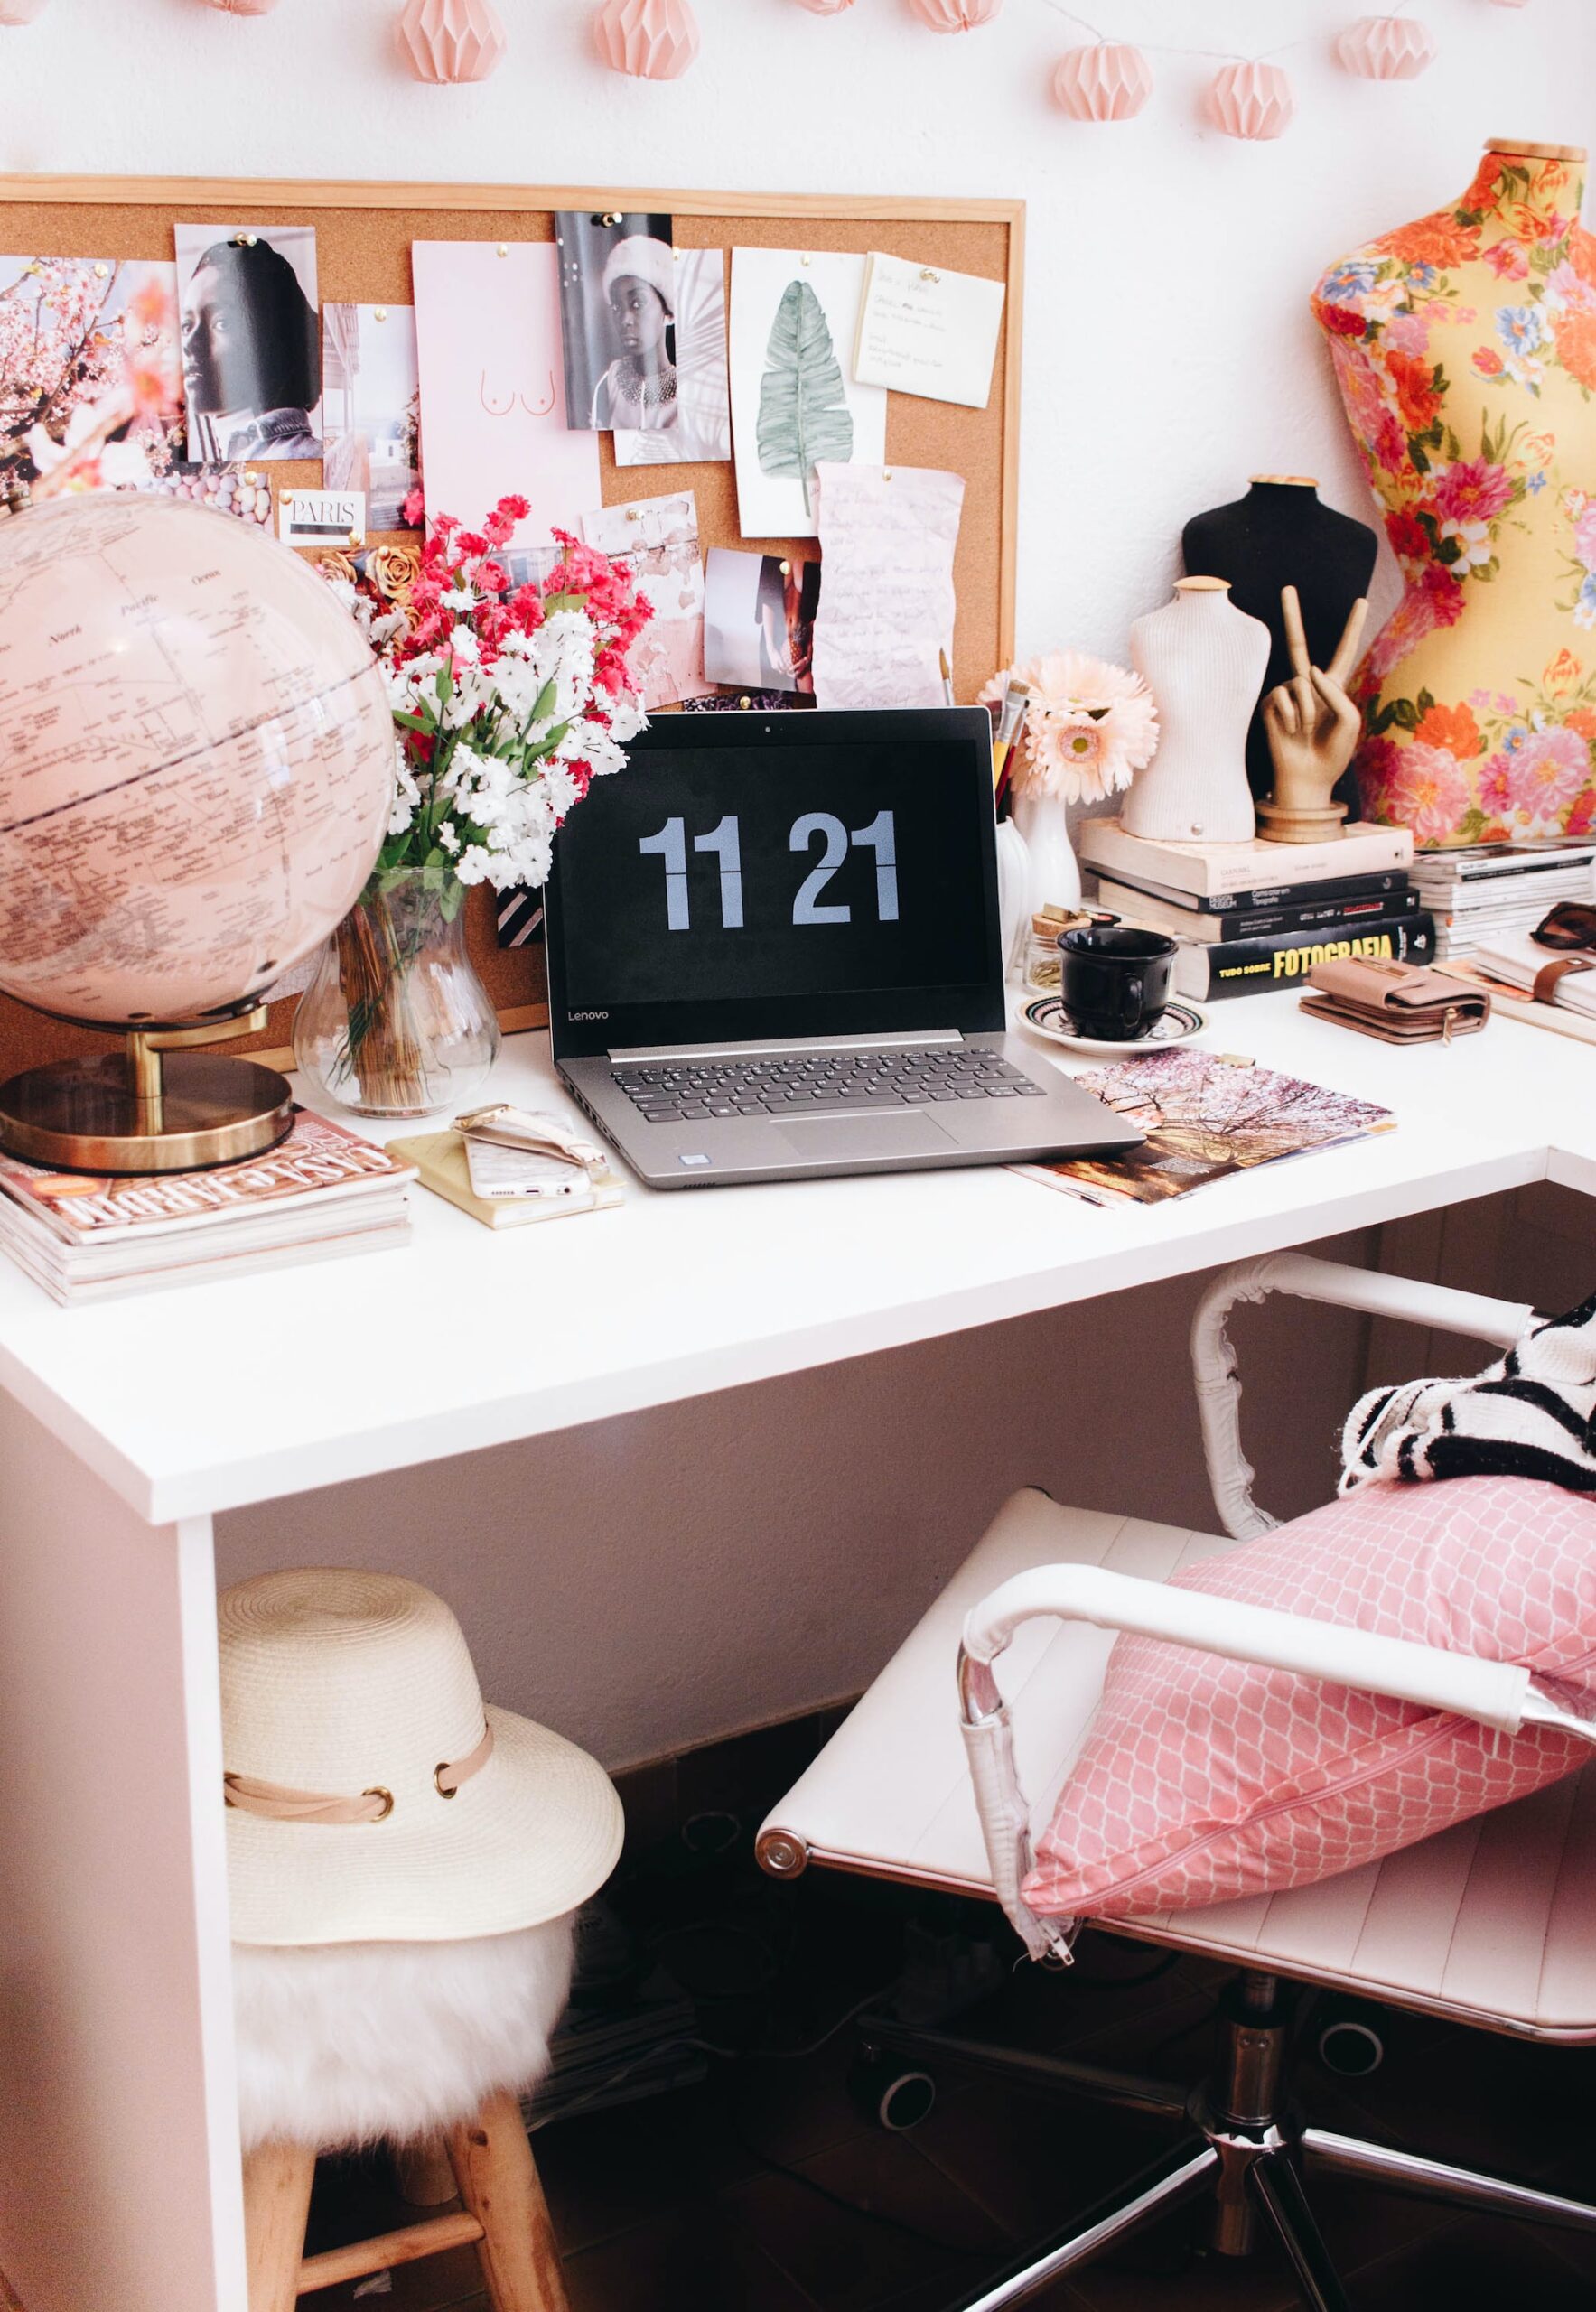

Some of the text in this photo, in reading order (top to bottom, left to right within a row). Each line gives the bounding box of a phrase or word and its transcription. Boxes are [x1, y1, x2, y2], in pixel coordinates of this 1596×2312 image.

[292, 500, 355, 523] PARIS
[48, 624, 82, 647] North
[639, 810, 900, 931] 11 21
[1219, 935, 1392, 978] TUDO SOBRE FOTOGRAFIA
[567, 1011, 609, 1021] Lenovo
[273, 1144, 394, 1185] CASA
[54, 1173, 243, 1226] JARDIM
